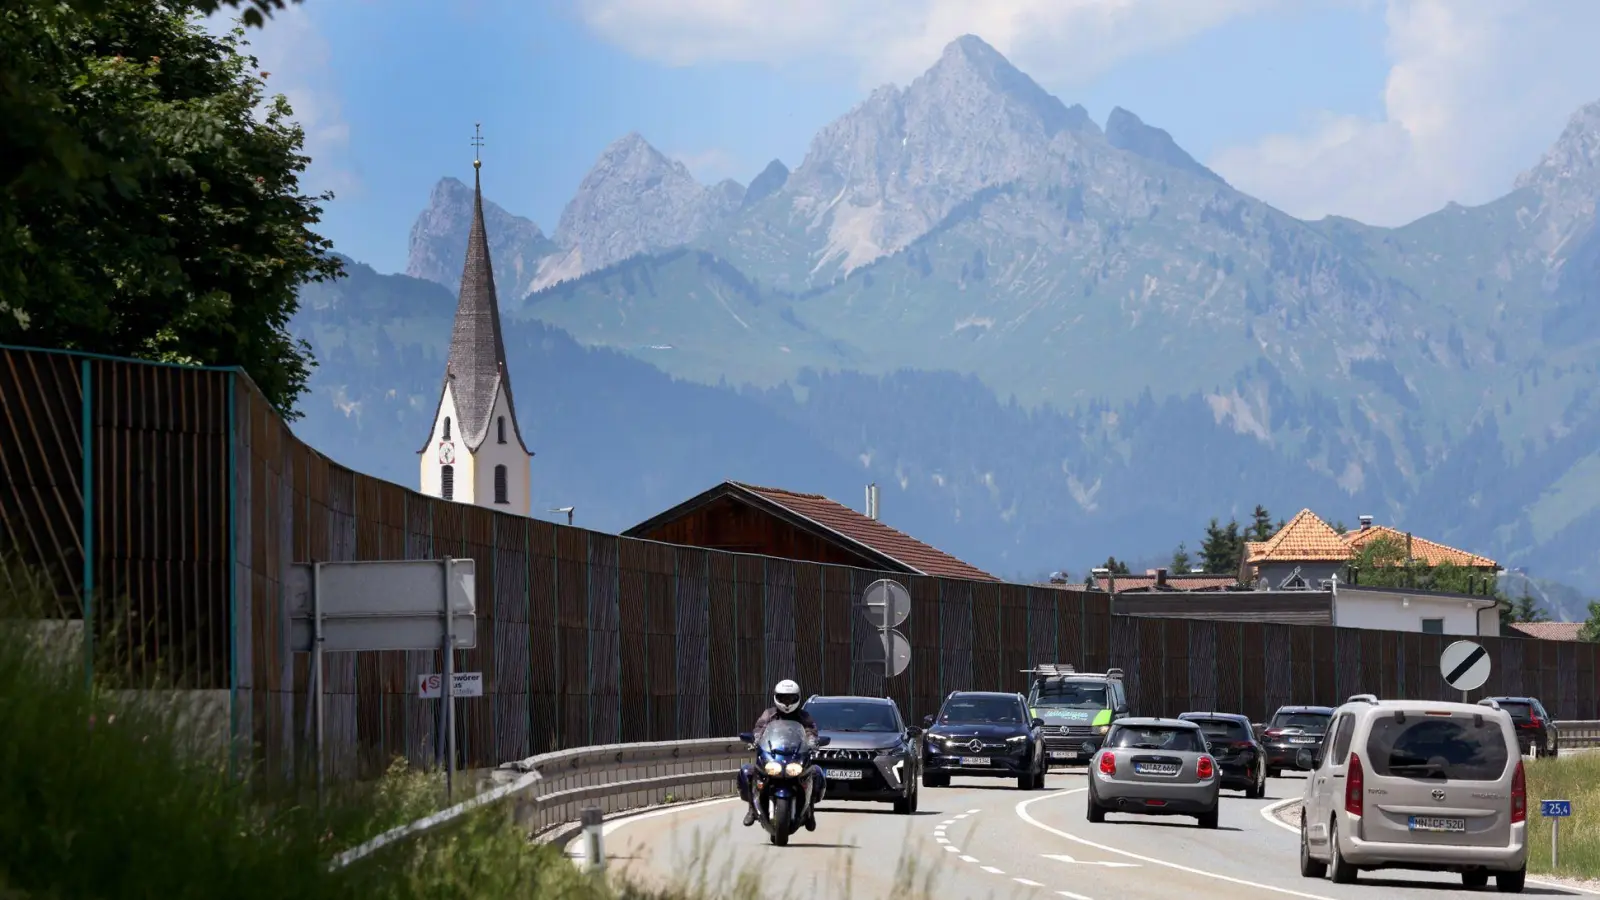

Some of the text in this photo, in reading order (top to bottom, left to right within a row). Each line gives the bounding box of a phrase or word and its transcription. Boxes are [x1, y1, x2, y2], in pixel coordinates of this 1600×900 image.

[849, 770, 861, 778] 212
[1549, 803, 1568, 815] 25,4
[1415, 819, 1464, 829] MN CF 520
